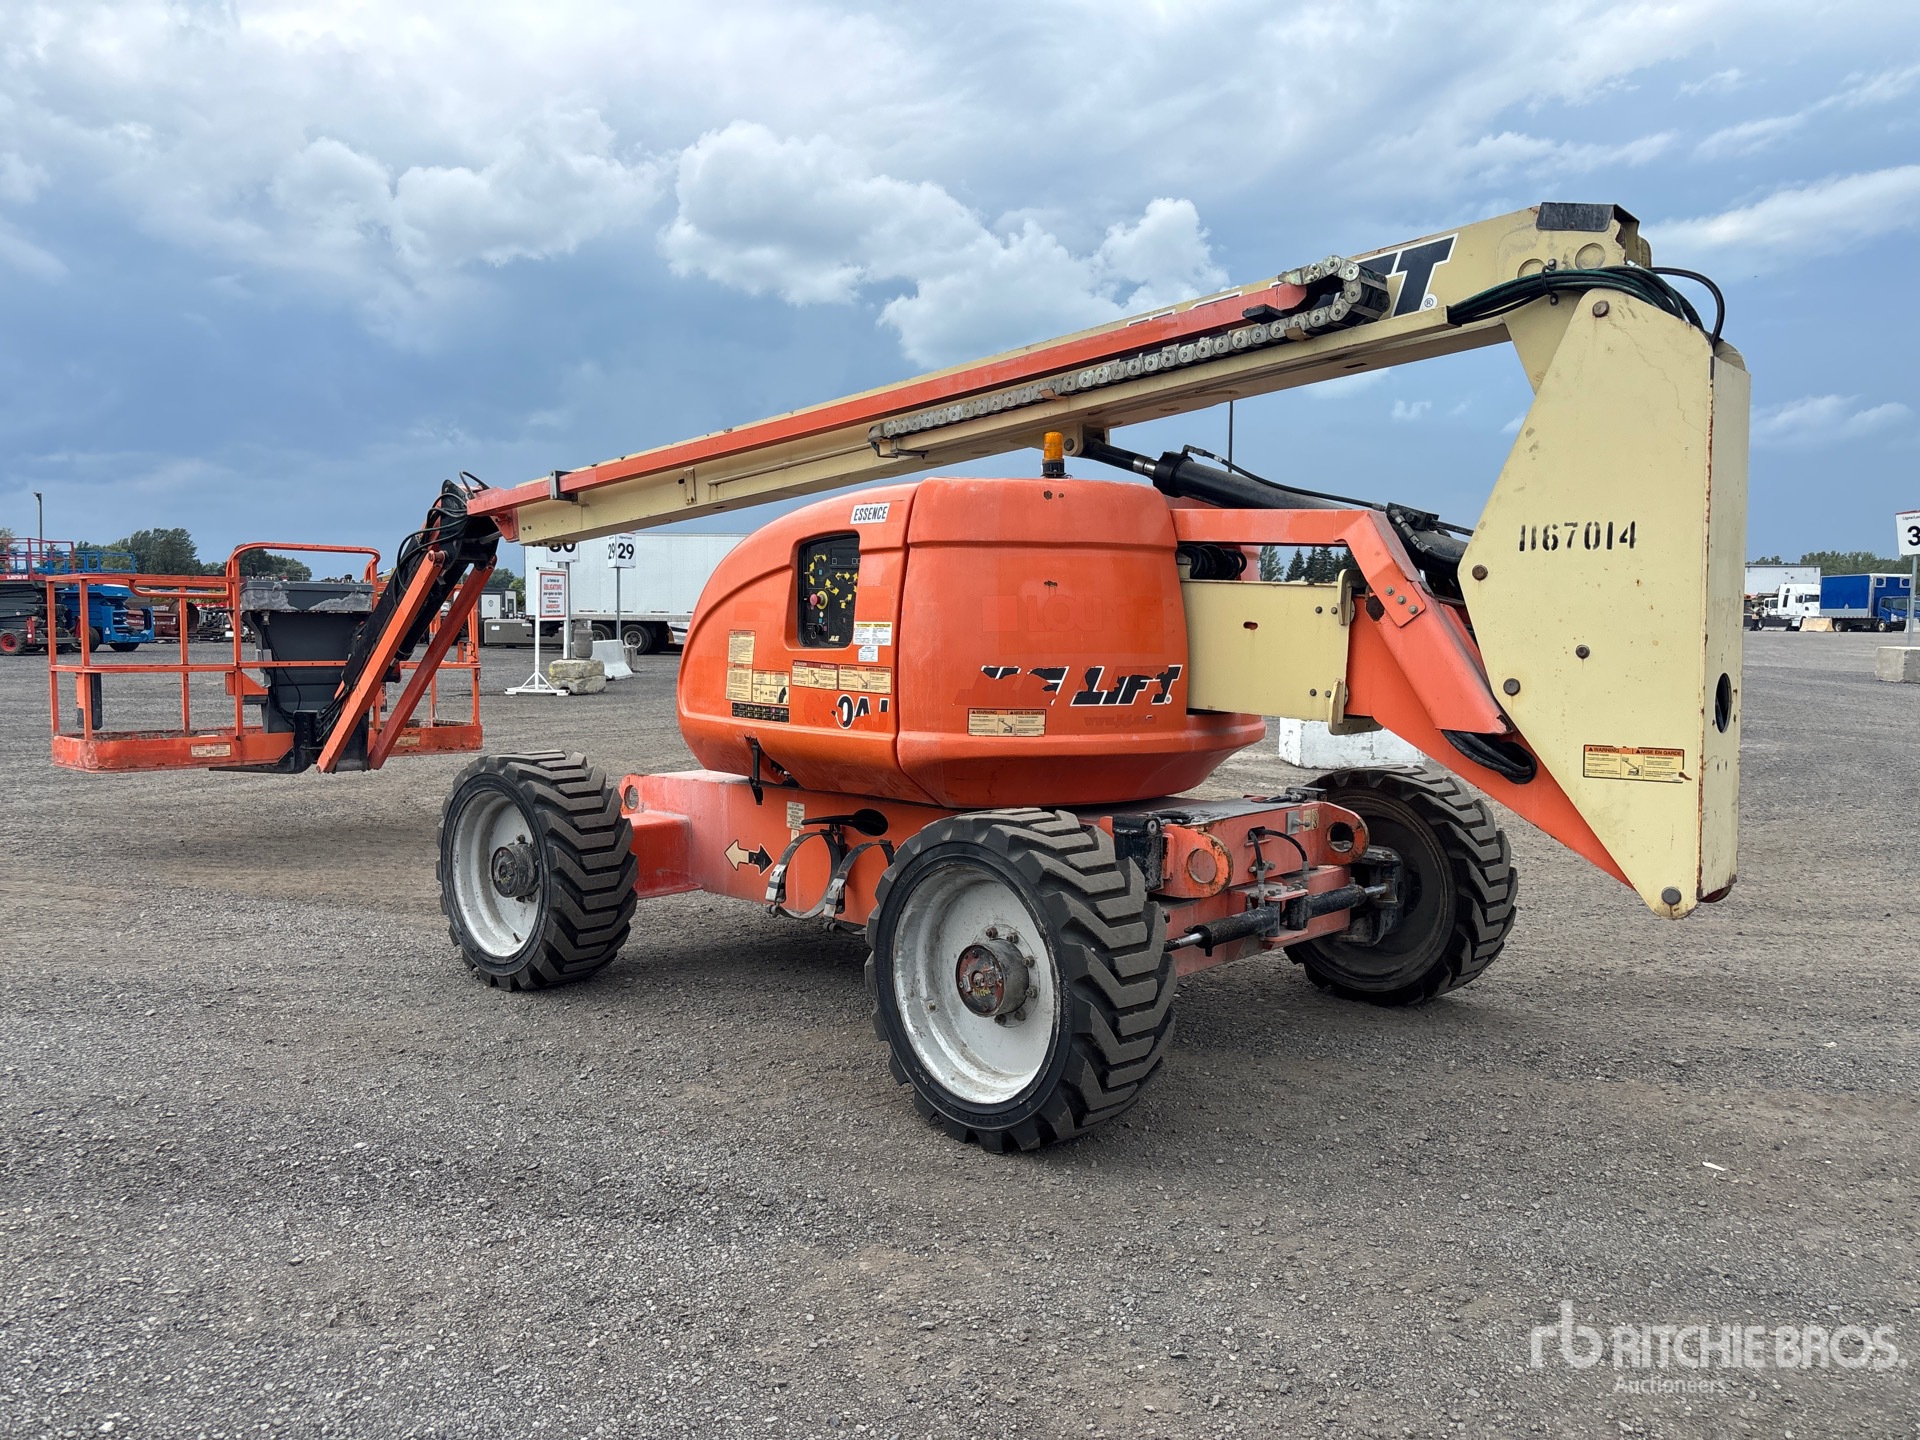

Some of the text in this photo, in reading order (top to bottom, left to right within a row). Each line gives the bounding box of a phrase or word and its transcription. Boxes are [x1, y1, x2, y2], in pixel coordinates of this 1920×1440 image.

[853, 505, 887, 522] ESSENCE
[1519, 521, 1636, 552] 1167014
[617, 542, 635, 560] 29
